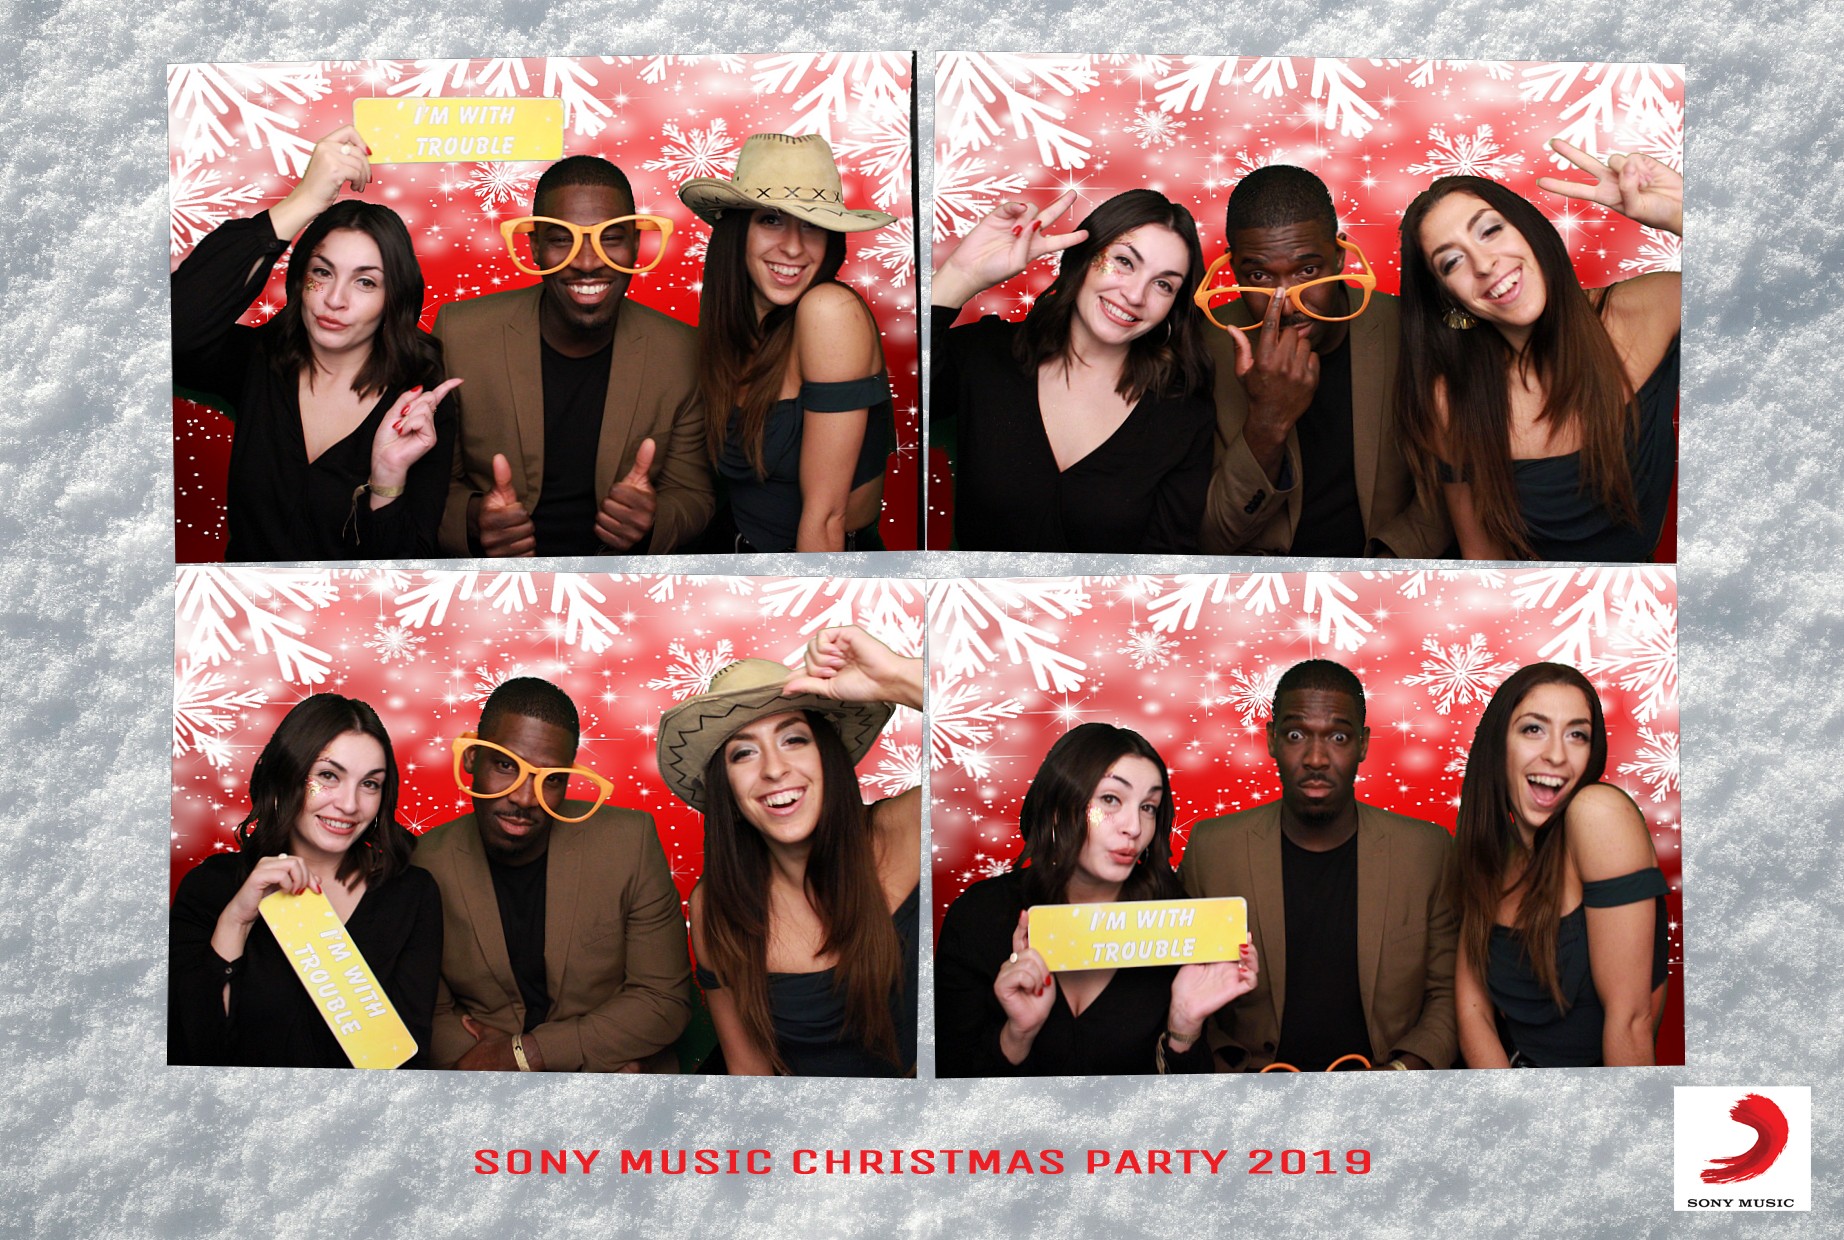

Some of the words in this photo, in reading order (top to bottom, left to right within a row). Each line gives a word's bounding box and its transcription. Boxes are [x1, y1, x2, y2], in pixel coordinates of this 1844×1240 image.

[413, 105, 449, 125] I'M
[459, 105, 516, 125] WITH
[416, 136, 516, 157] TROUBLE
[1089, 910, 1127, 931] I'M
[1137, 907, 1196, 929] WITH
[1092, 937, 1196, 963] TROUBLE
[319, 928, 353, 963] I'M
[343, 965, 387, 1018] WITH
[294, 942, 363, 1036] TROUBLE
